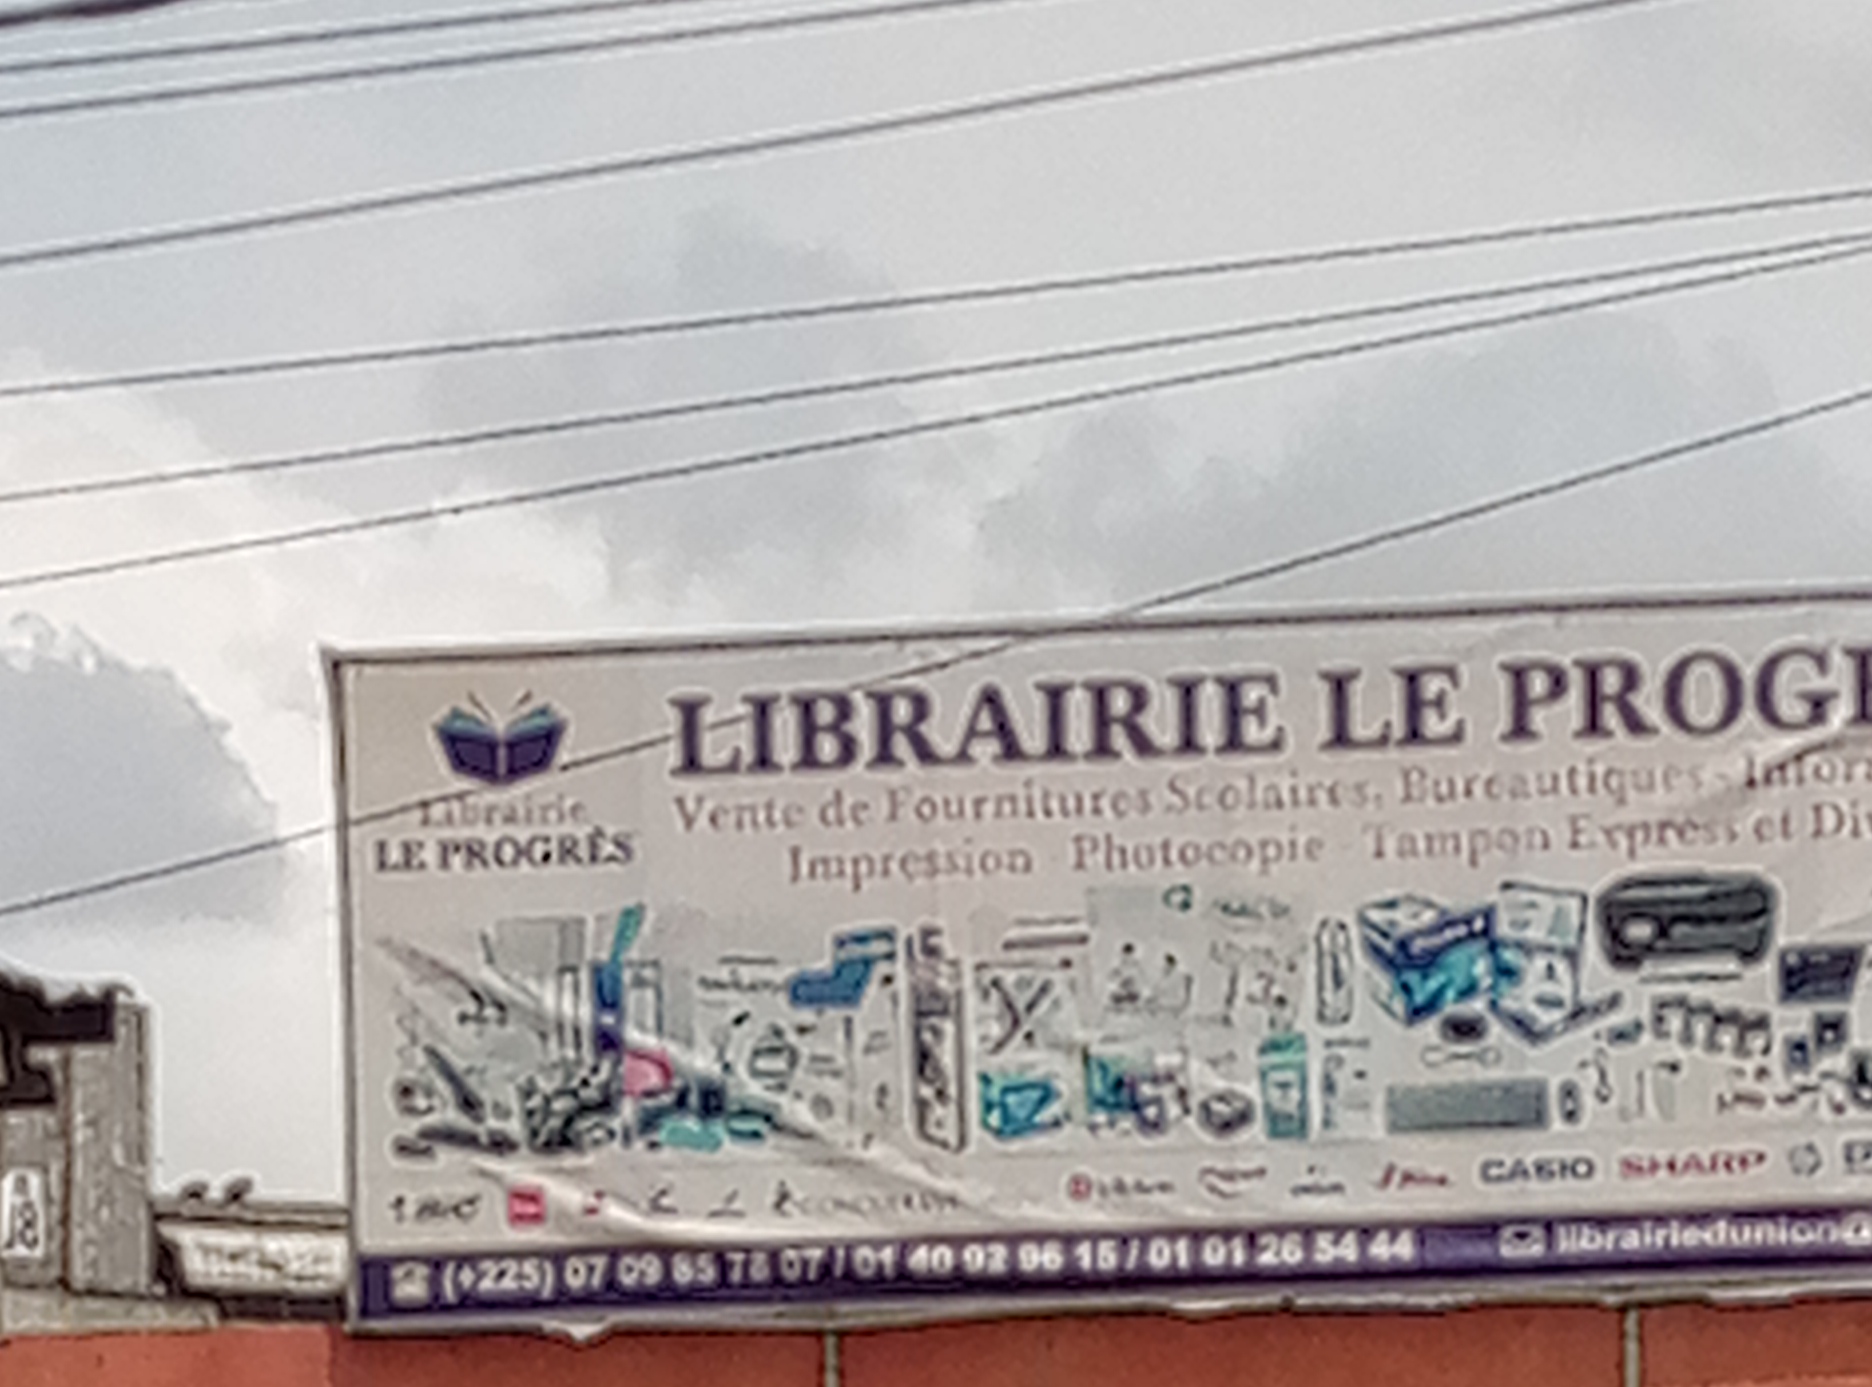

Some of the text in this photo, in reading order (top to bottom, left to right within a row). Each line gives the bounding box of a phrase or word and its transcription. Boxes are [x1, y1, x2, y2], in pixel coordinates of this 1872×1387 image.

[668, 670, 1286, 777] LIBRAIRIE
[1318, 661, 1466, 752] LE
[419, 793, 586, 827] Librairie
[674, 795, 803, 833] Vente
[818, 788, 870, 828] de
[886, 778, 1152, 824] Fournitures
[1401, 757, 1704, 805] Bureautiques
[373, 825, 635, 873] LE PROGRÈS
[788, 836, 1034, 893] Impression
[1072, 824, 1325, 876] Photocopie
[1361, 818, 1551, 869] Tampon
[1568, 811, 1739, 860] Express
[1754, 808, 1794, 843] et
[1479, 1157, 1596, 1186] CASIO
[1618, 1150, 1766, 1181] SHARP
[442, 1258, 553, 1304] (+225)
[564, 1254, 608, 1289] 07
[618, 1252, 663, 1287] 09
[778, 1246, 824, 1282] 07
[853, 1245, 896, 1279] 01
[906, 1243, 952, 1275] 40
[1074, 1238, 1117, 1272] 15
[1149, 1235, 1190, 1269] 01
[1203, 1232, 1245, 1267] 01
[1256, 1231, 1303, 1266] 26
[1312, 1228, 1359, 1264] 54
[1367, 1228, 1415, 1263] 44
